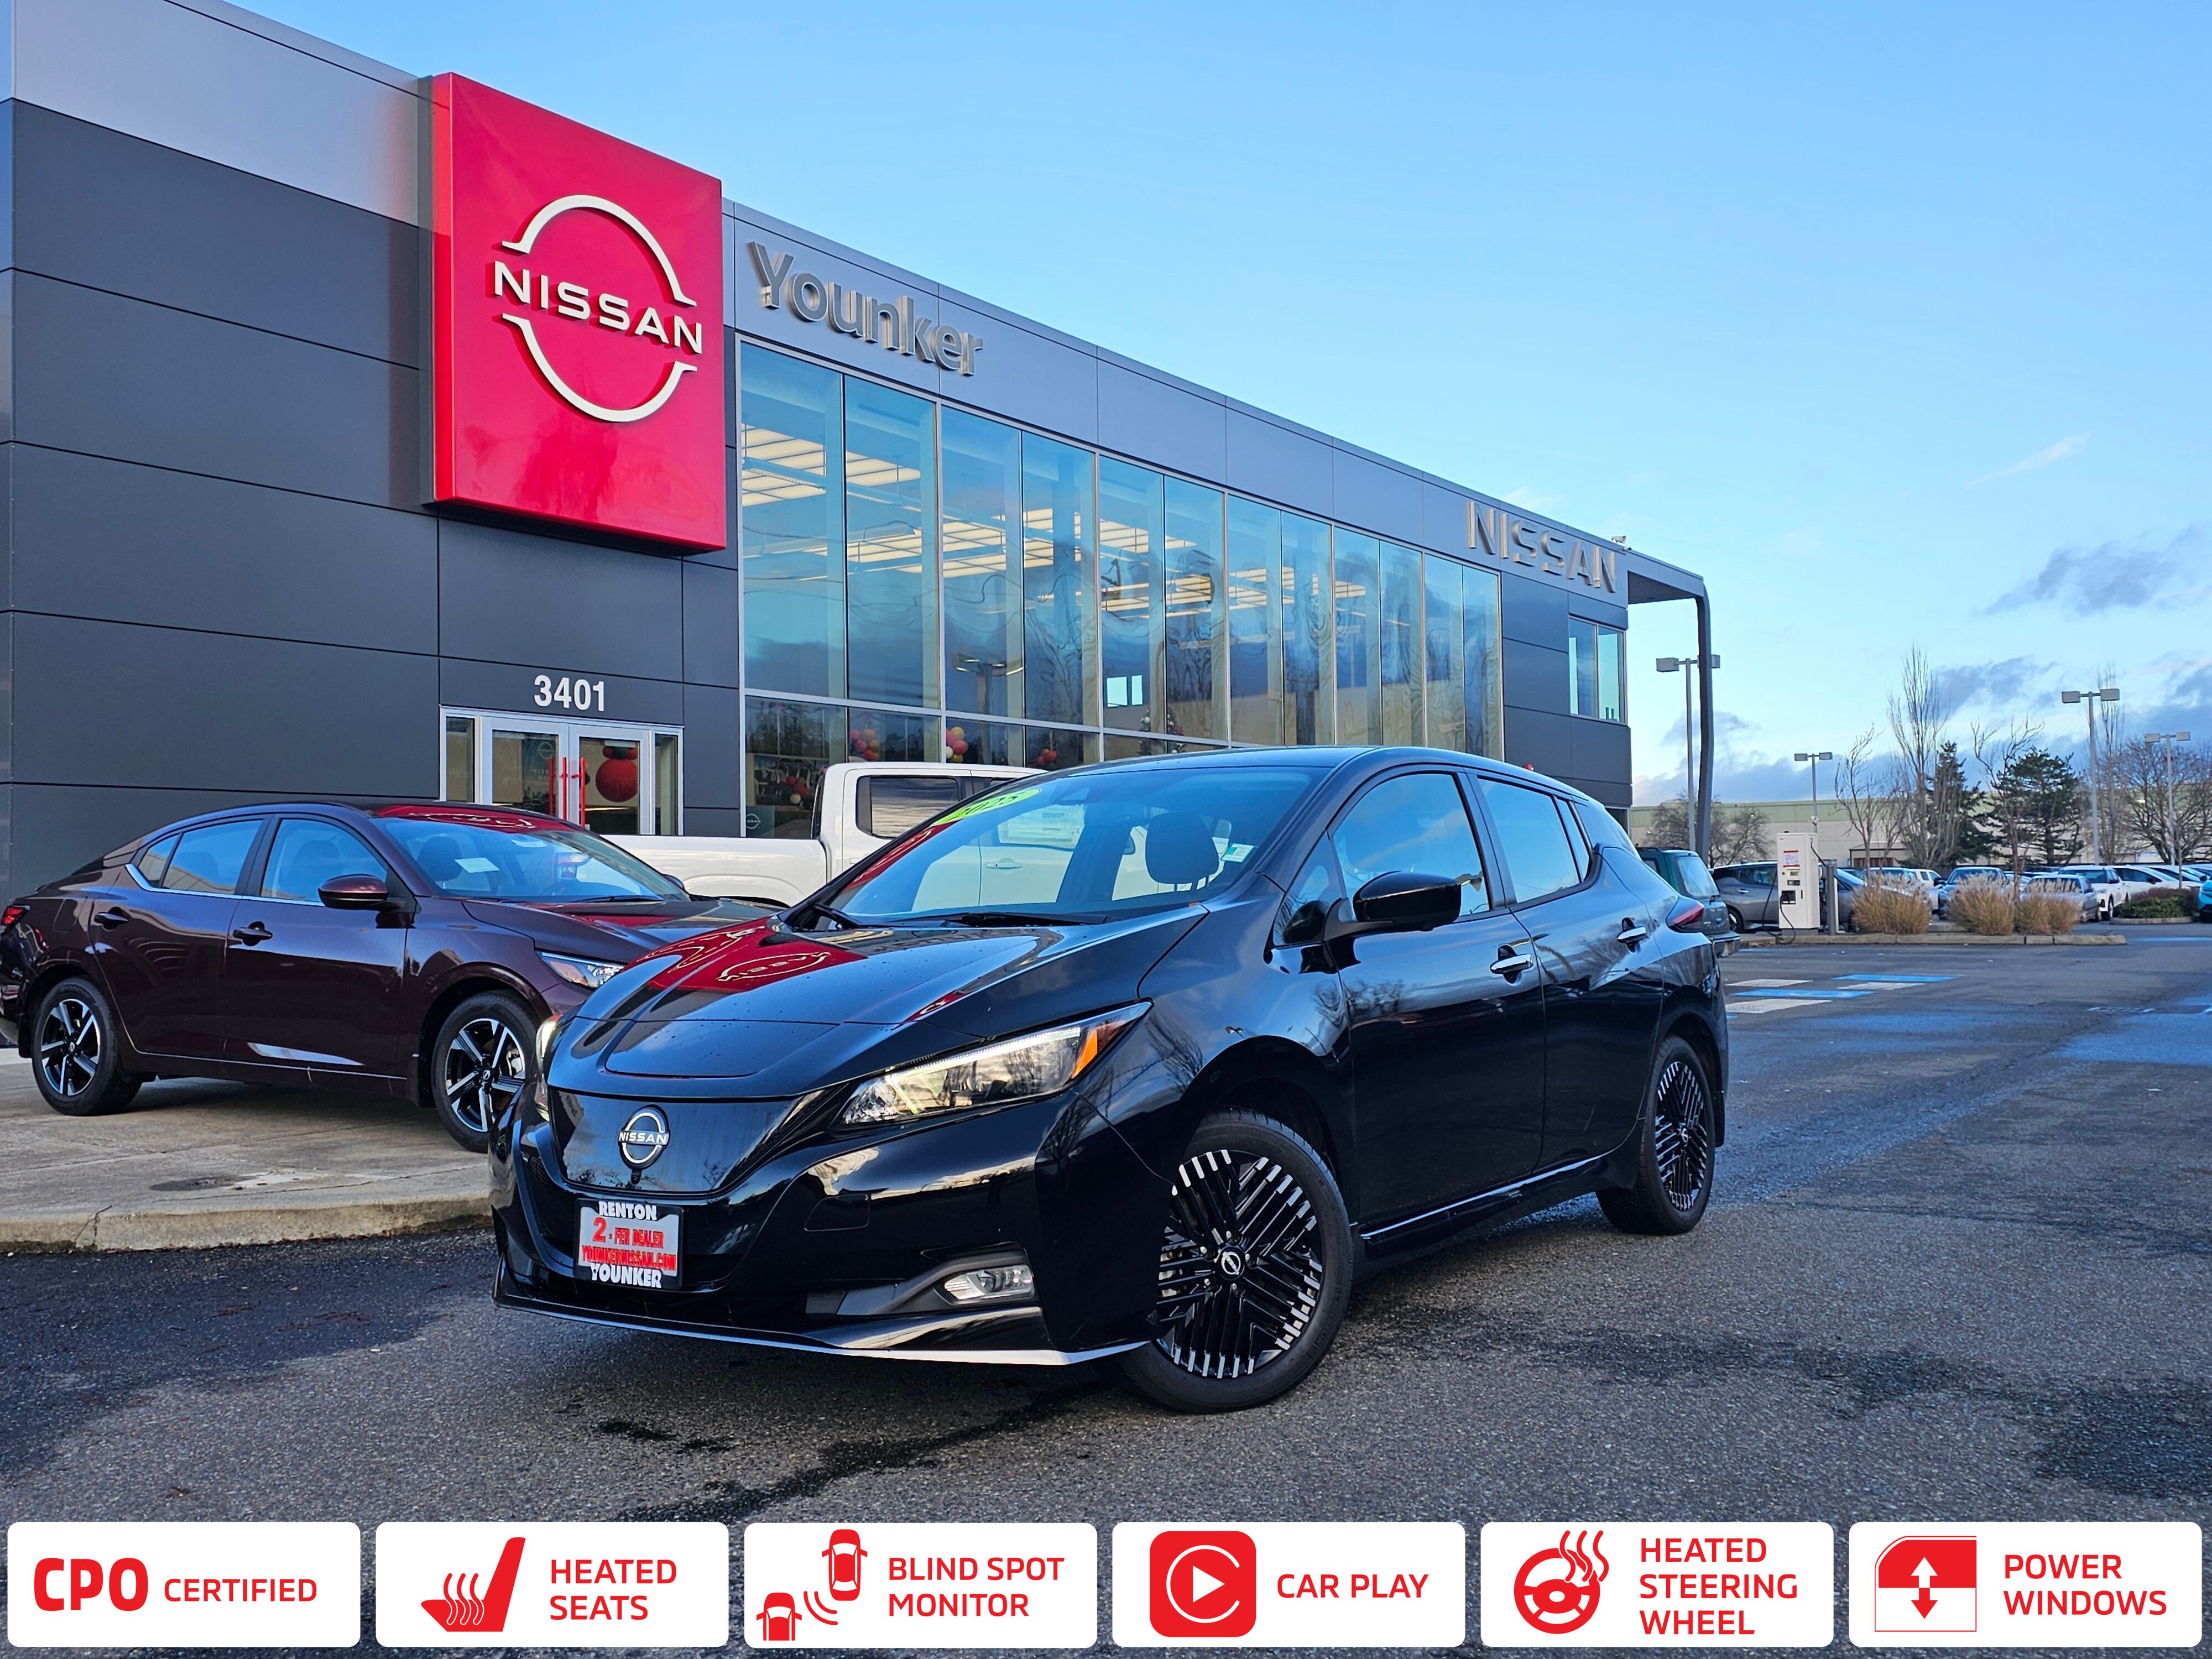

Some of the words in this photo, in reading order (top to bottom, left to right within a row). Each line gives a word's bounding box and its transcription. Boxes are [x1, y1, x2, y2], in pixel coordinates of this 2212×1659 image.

[494, 260, 702, 354] NISSAN
[749, 241, 984, 377] Younker
[1468, 501, 1616, 593] NISSAN
[534, 675, 604, 711] 3401
[619, 1131, 667, 1144] NISSAN
[598, 1201, 657, 1221] RENTON
[632, 1229, 664, 1249] DEALER
[589, 1262, 662, 1288] YOUNKER
